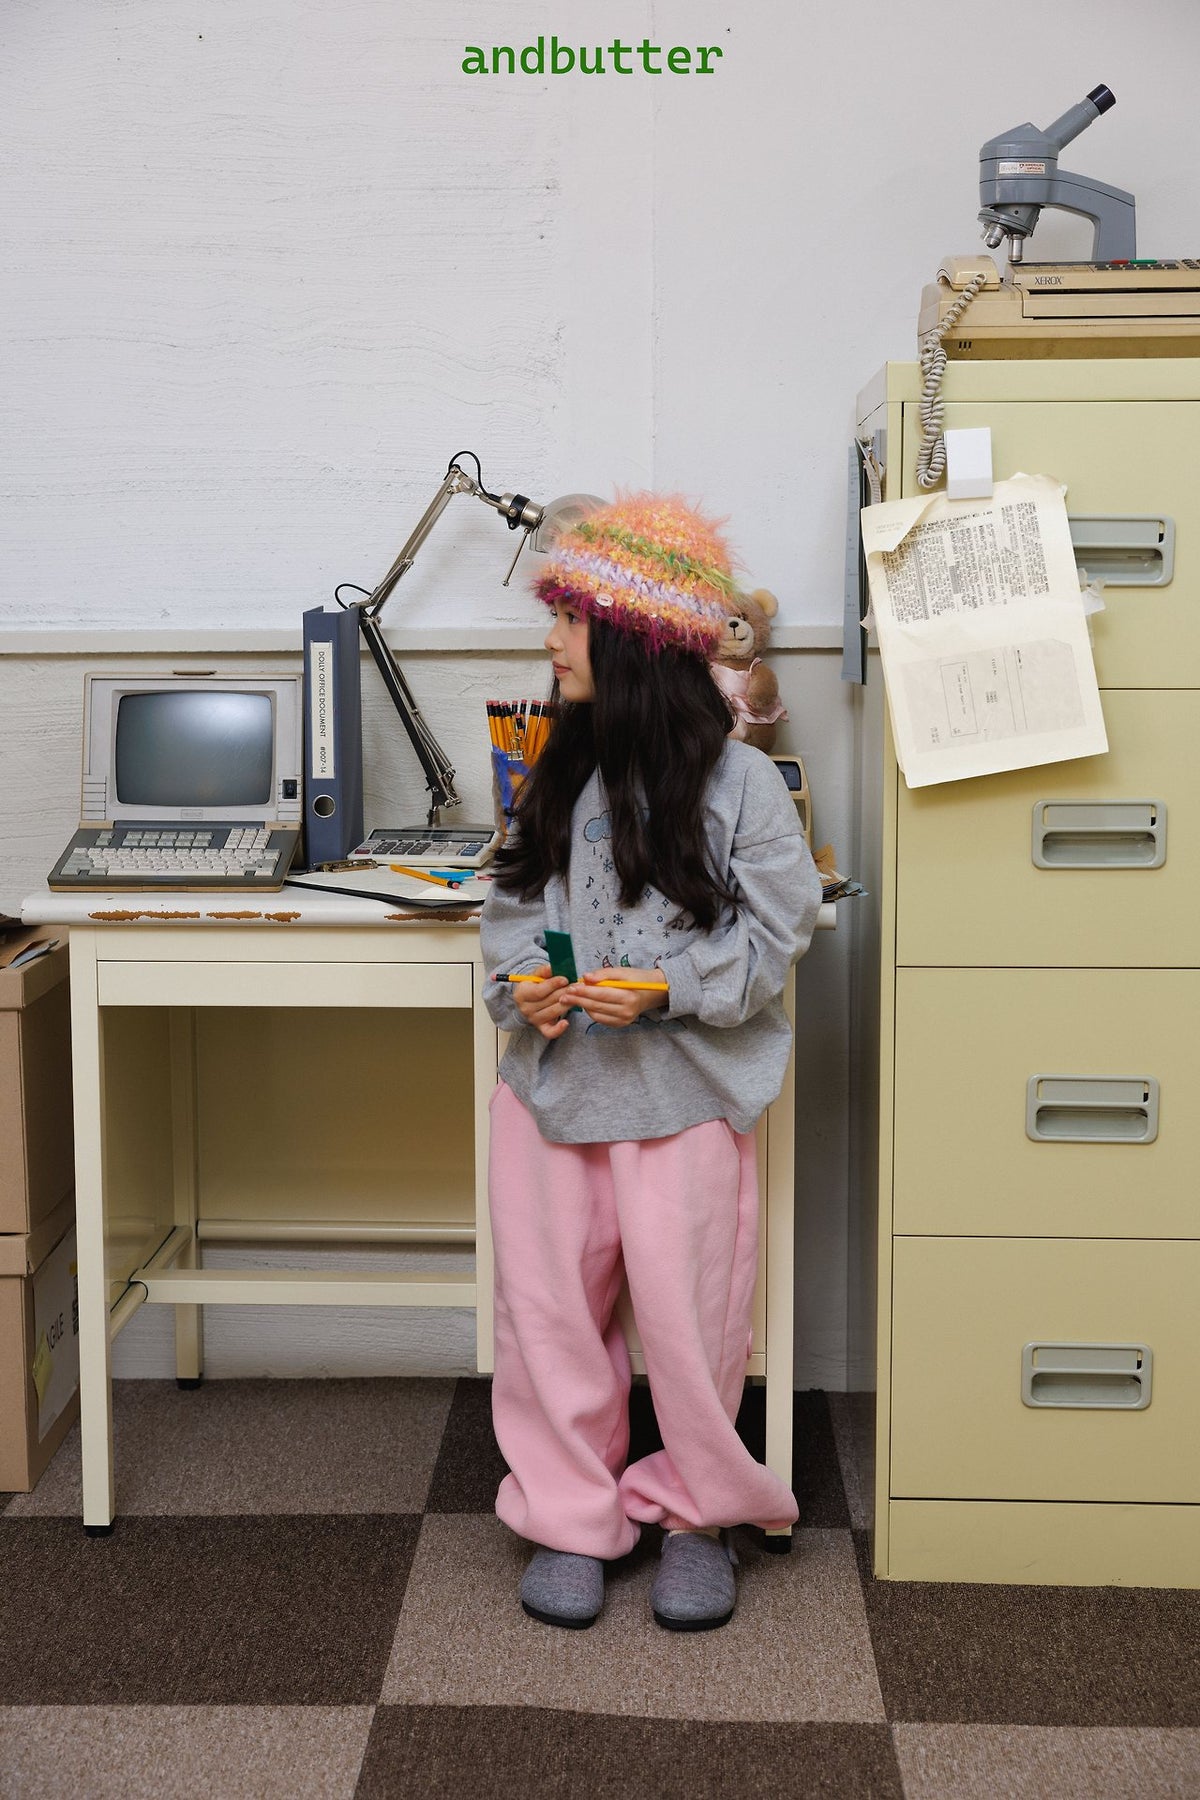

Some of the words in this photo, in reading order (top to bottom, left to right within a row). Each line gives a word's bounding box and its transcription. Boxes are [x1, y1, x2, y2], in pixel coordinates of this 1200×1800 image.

[1034, 276, 1063, 286] XEROX
[318, 651, 326, 672] DOLLY
[318, 672, 326, 697] OFFICE
[318, 697, 326, 737] DOCUMENT
